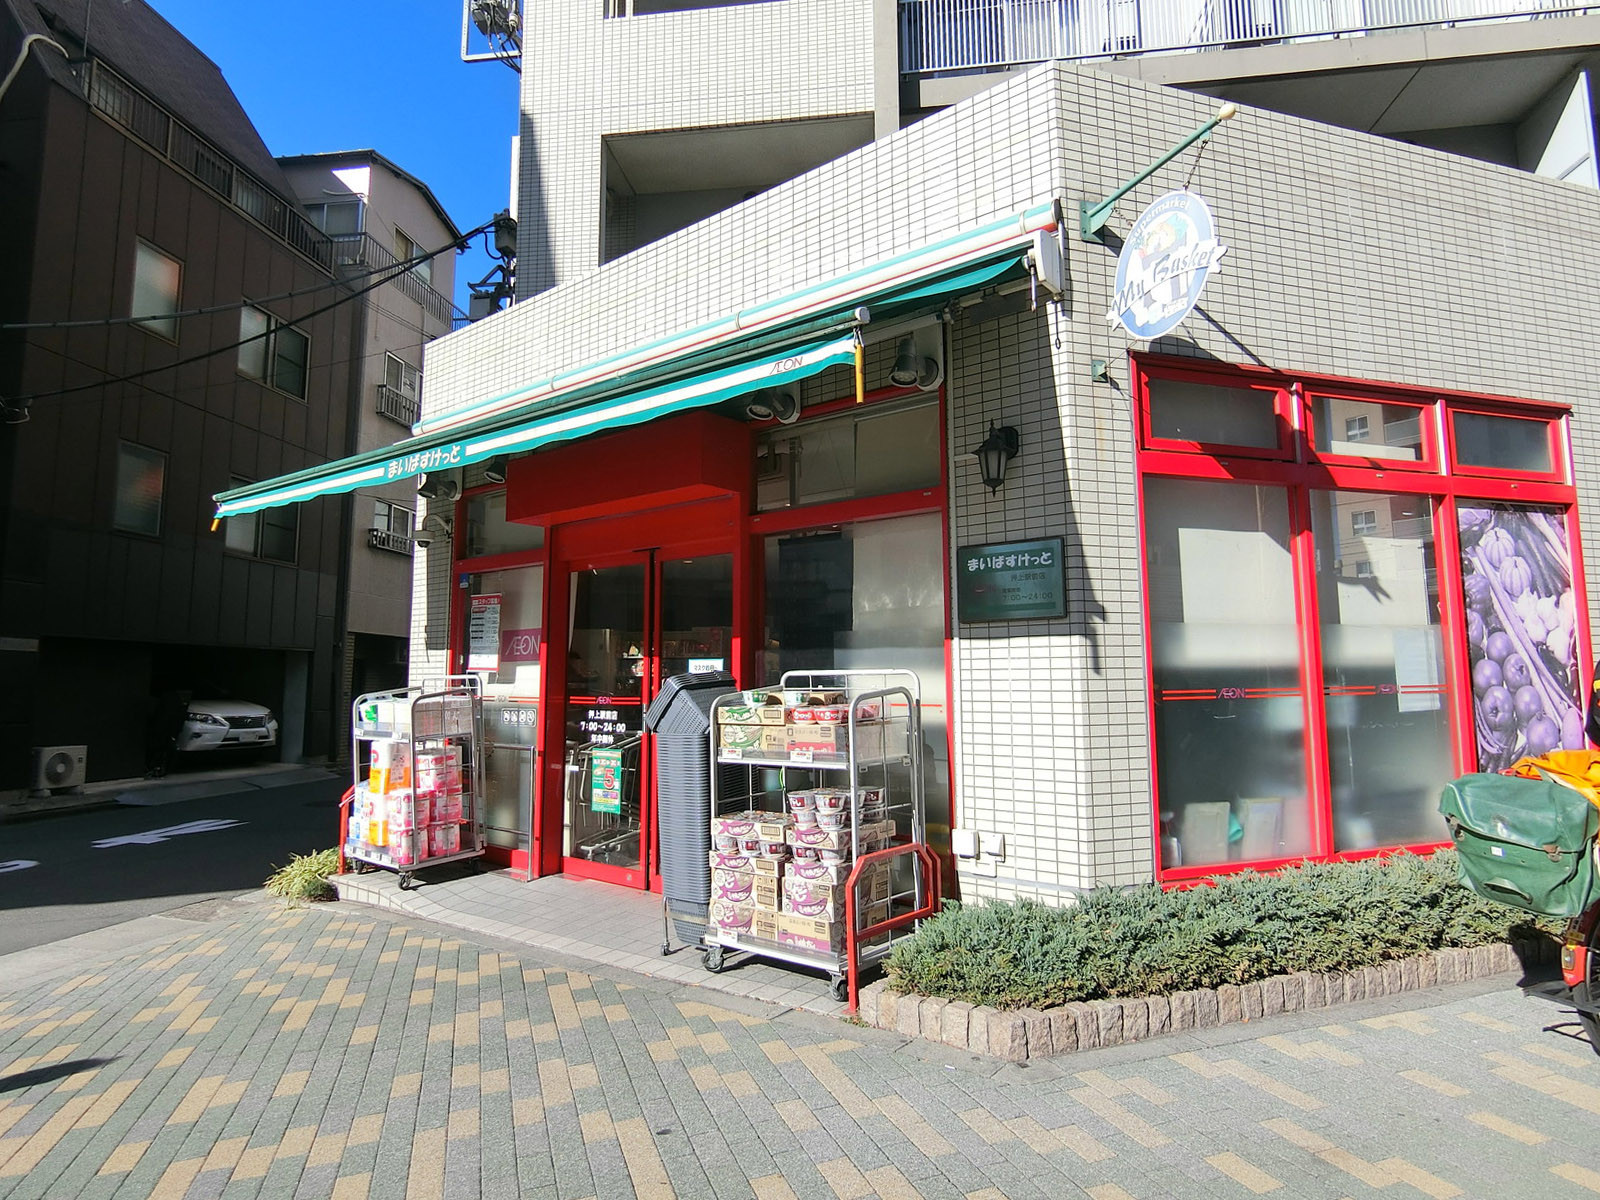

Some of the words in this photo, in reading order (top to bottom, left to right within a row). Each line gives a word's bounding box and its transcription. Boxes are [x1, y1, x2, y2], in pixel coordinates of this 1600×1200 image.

[1111, 279, 1145, 316] My
[1153, 242, 1215, 283] Basket
[387, 445, 460, 479] まいばすけっと
[967, 551, 1052, 572] まいばすけっと
